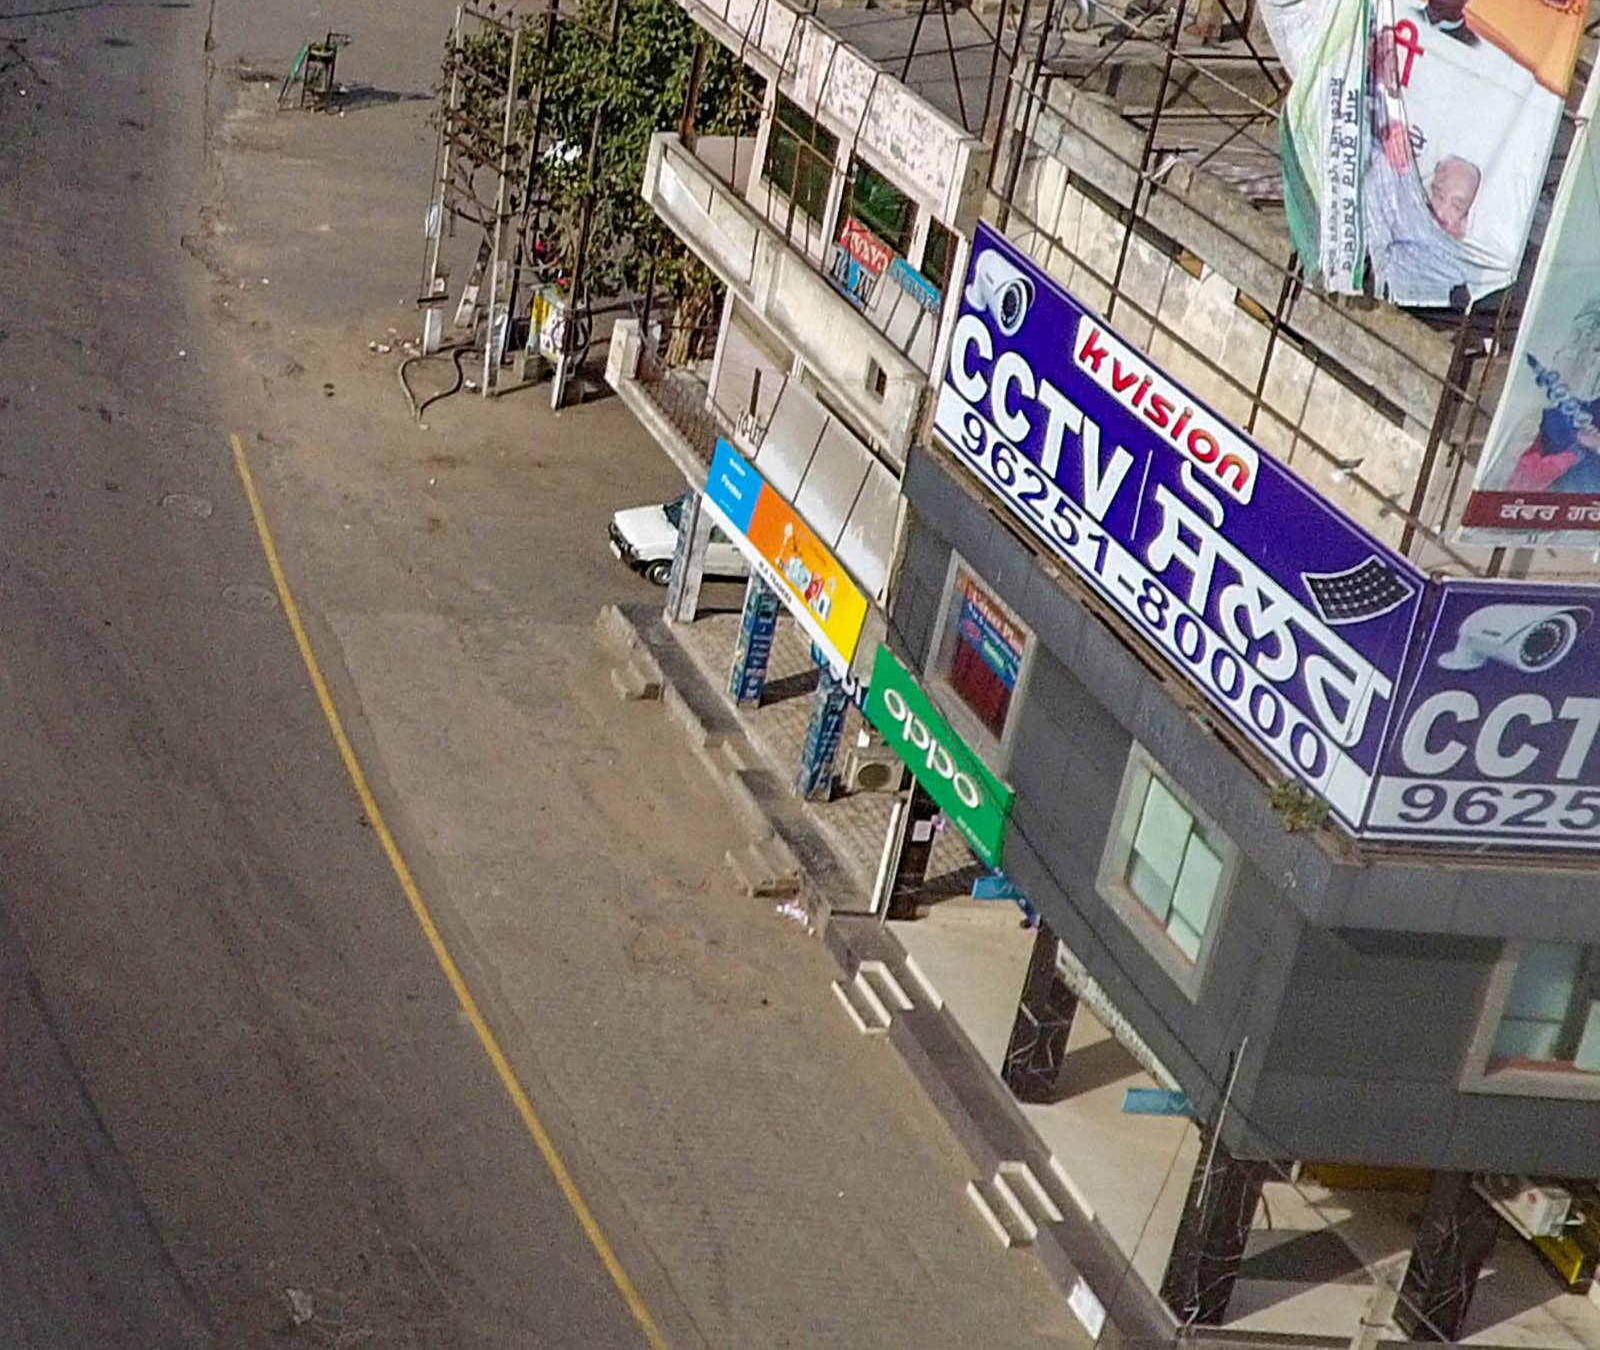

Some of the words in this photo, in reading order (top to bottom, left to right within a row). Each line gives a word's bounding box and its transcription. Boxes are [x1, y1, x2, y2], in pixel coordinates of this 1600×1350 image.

[1076, 320, 1257, 500] kvision
[943, 303, 1136, 538] CCTV
[1138, 442, 1406, 772] ਸੋਲਰ
[1500, 498, 1559, 523] ਕੰਵਰ
[957, 406, 1333, 789] 96251-80000
[883, 687, 980, 809] oppo
[1402, 690, 1600, 781] CCT
[1397, 783, 1600, 831] 9625
